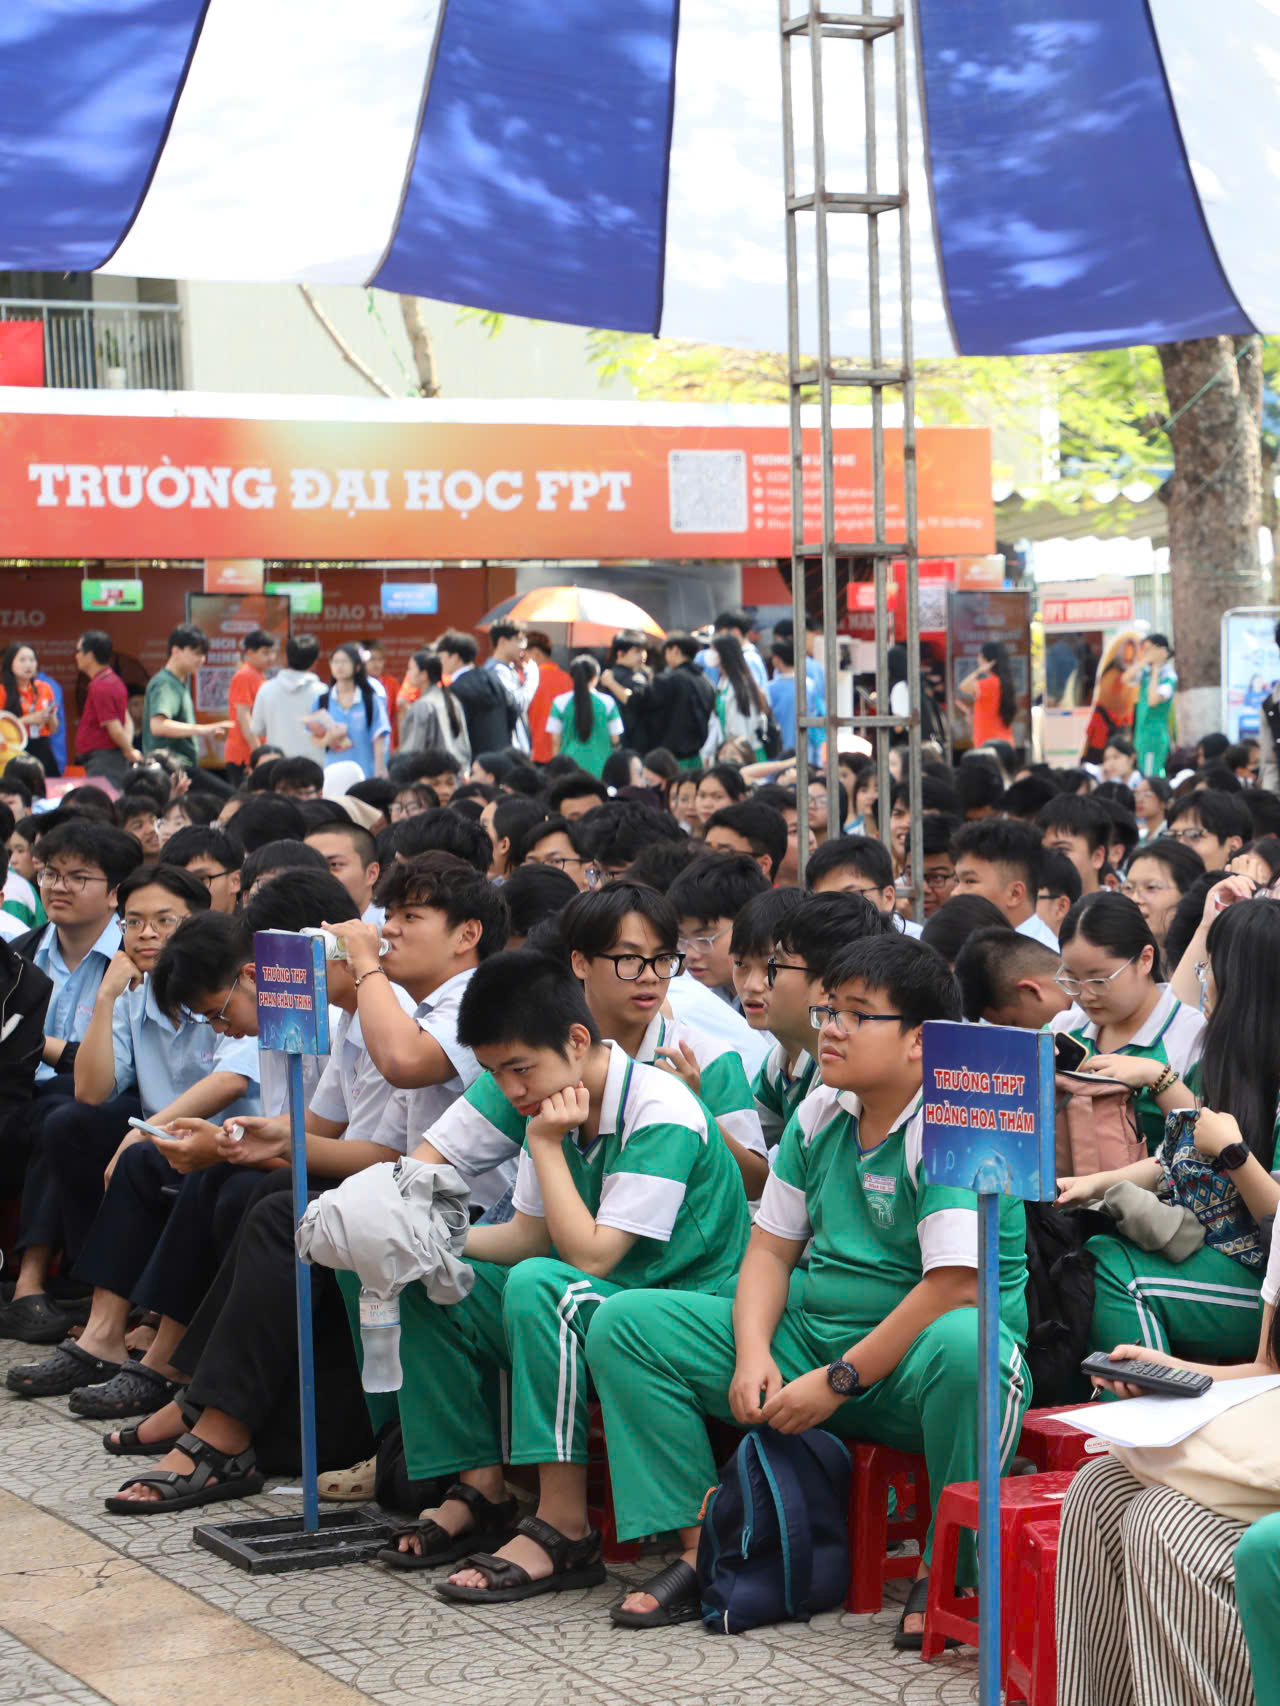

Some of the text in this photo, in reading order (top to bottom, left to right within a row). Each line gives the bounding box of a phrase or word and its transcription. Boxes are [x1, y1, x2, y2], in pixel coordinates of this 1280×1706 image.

[28, 456, 632, 519] TRƯỜNG ĐẠI HỌC FPT
[262, 963, 307, 985] TRƯỜNG THPT
[258, 989, 313, 1011] PHAN CHÂU TRINH
[933, 1065, 1026, 1097] TRƯỜNG THPT
[925, 1099, 1035, 1134] HOÀNG HOA THÁM
